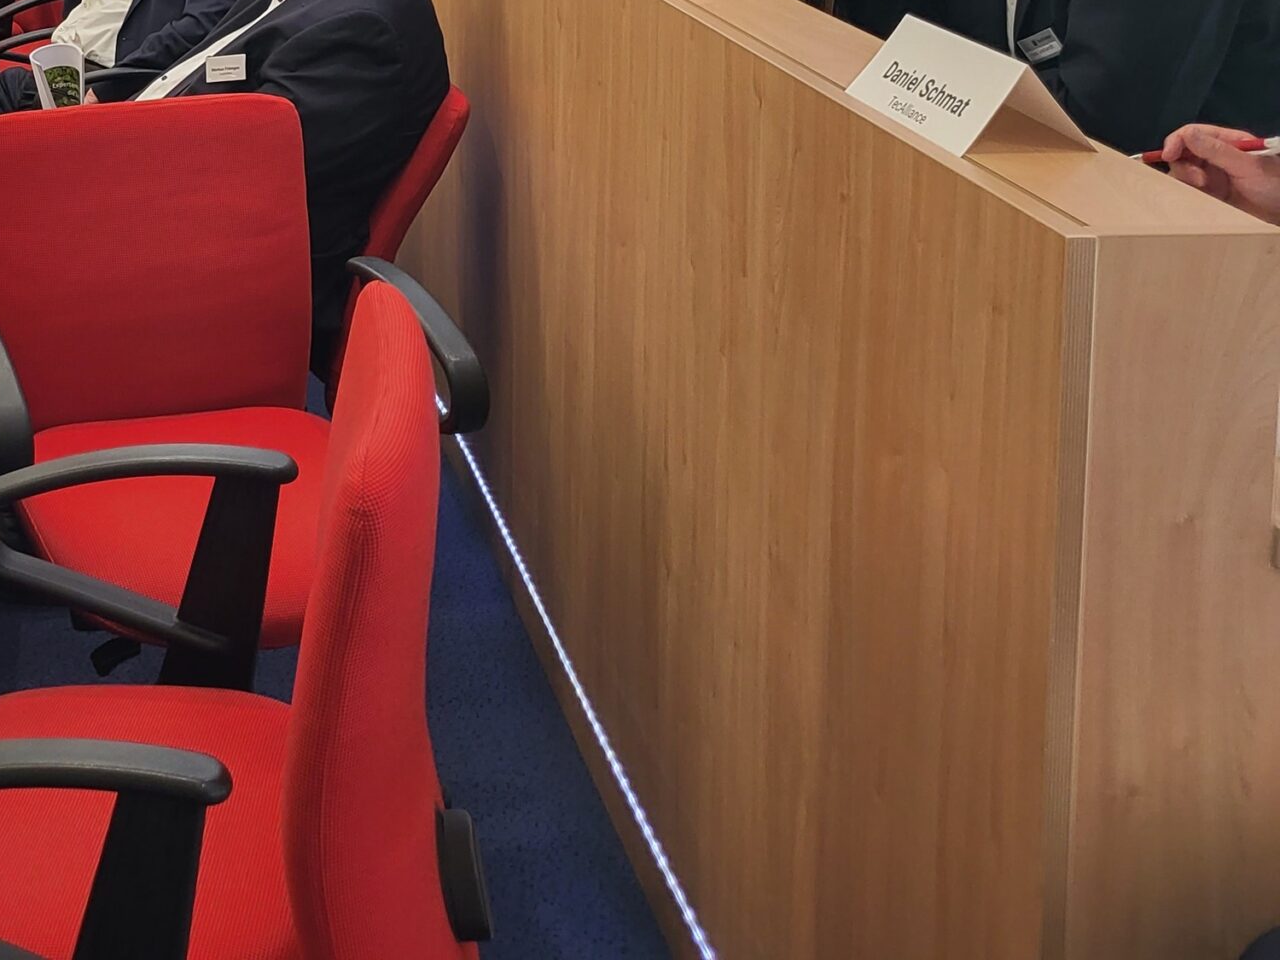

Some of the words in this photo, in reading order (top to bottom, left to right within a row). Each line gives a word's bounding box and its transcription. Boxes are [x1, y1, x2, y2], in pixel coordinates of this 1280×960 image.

[882, 60, 927, 93] Daniel
[919, 78, 971, 118] Schmat
[888, 95, 927, 125] TecAlliance
